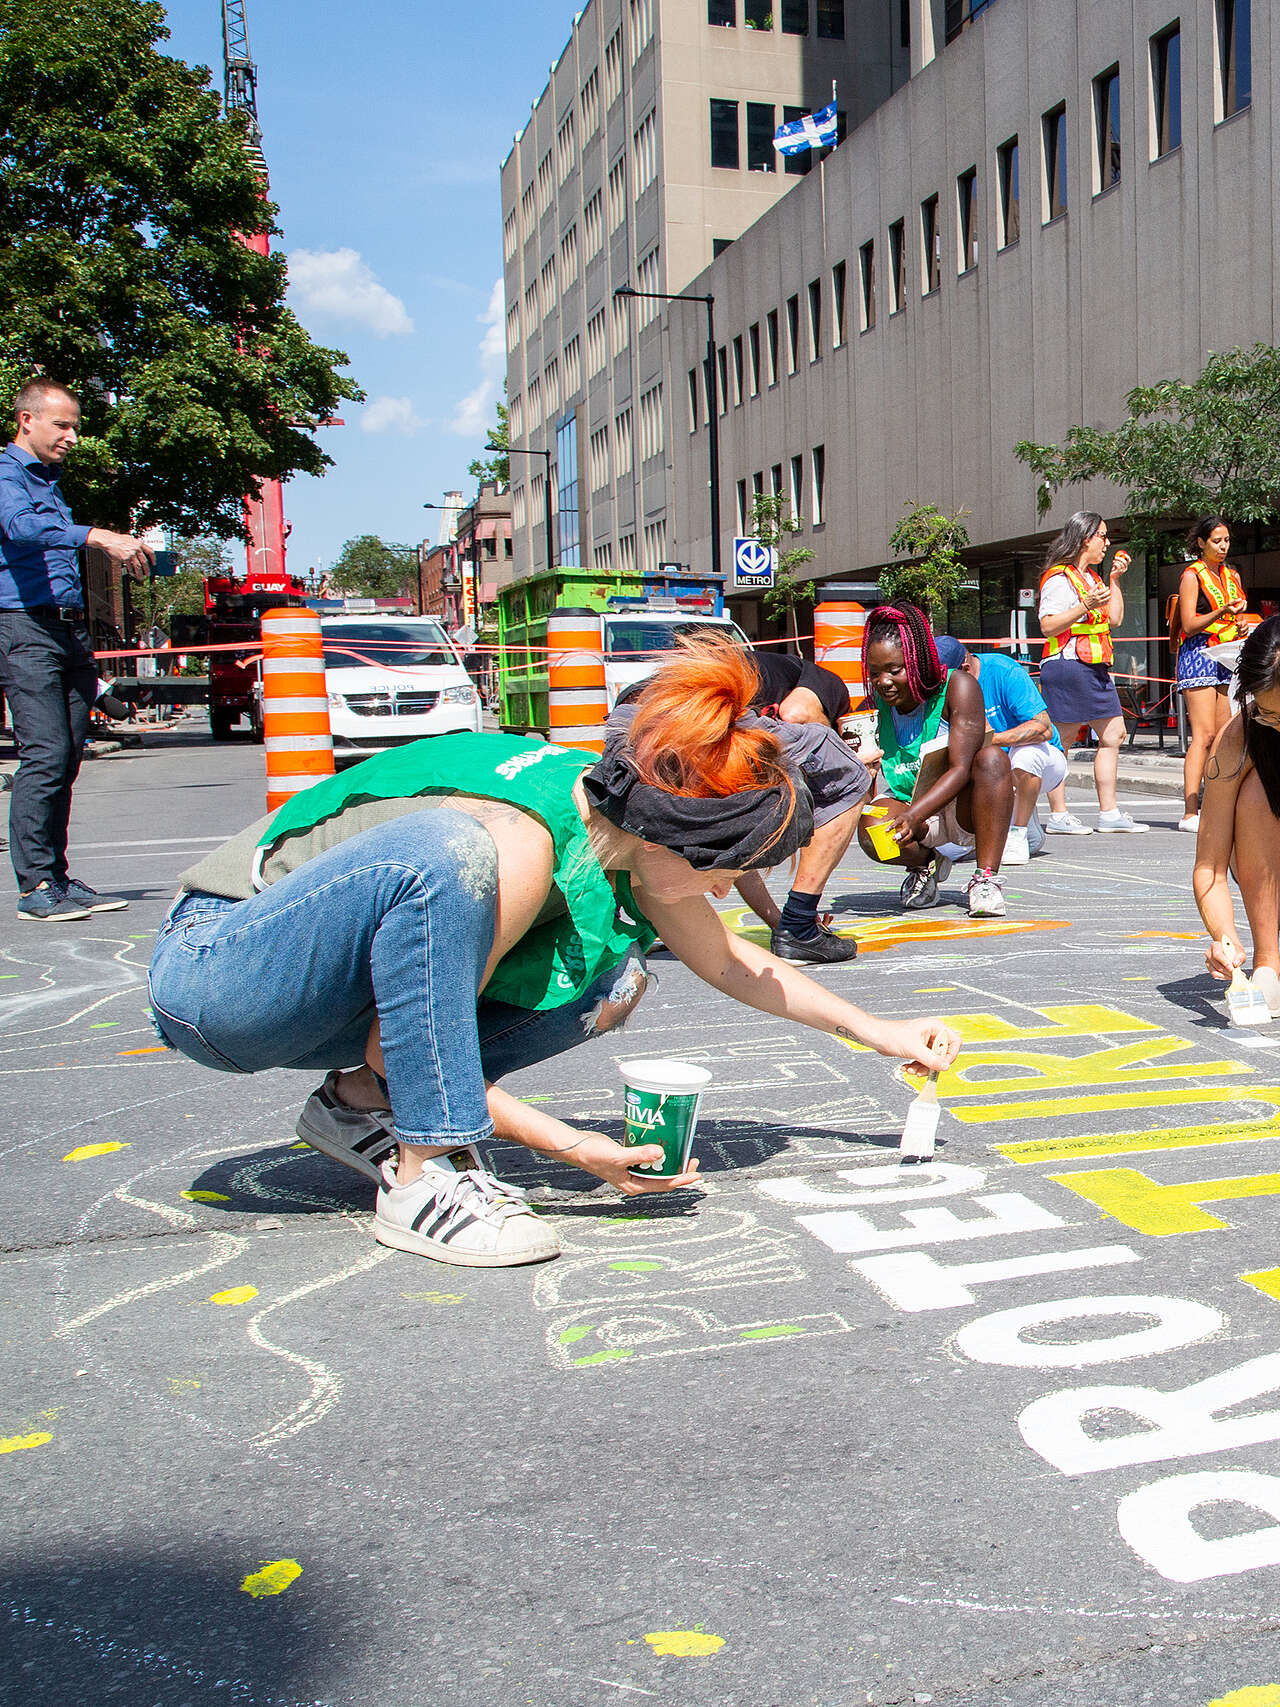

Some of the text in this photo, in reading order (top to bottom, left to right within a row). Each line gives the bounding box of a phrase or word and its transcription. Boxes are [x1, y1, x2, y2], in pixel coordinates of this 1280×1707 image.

[737, 575, 771, 585] METRO
[252, 583, 286, 591] GUAY
[624, 1101, 666, 1126] TIVIA
